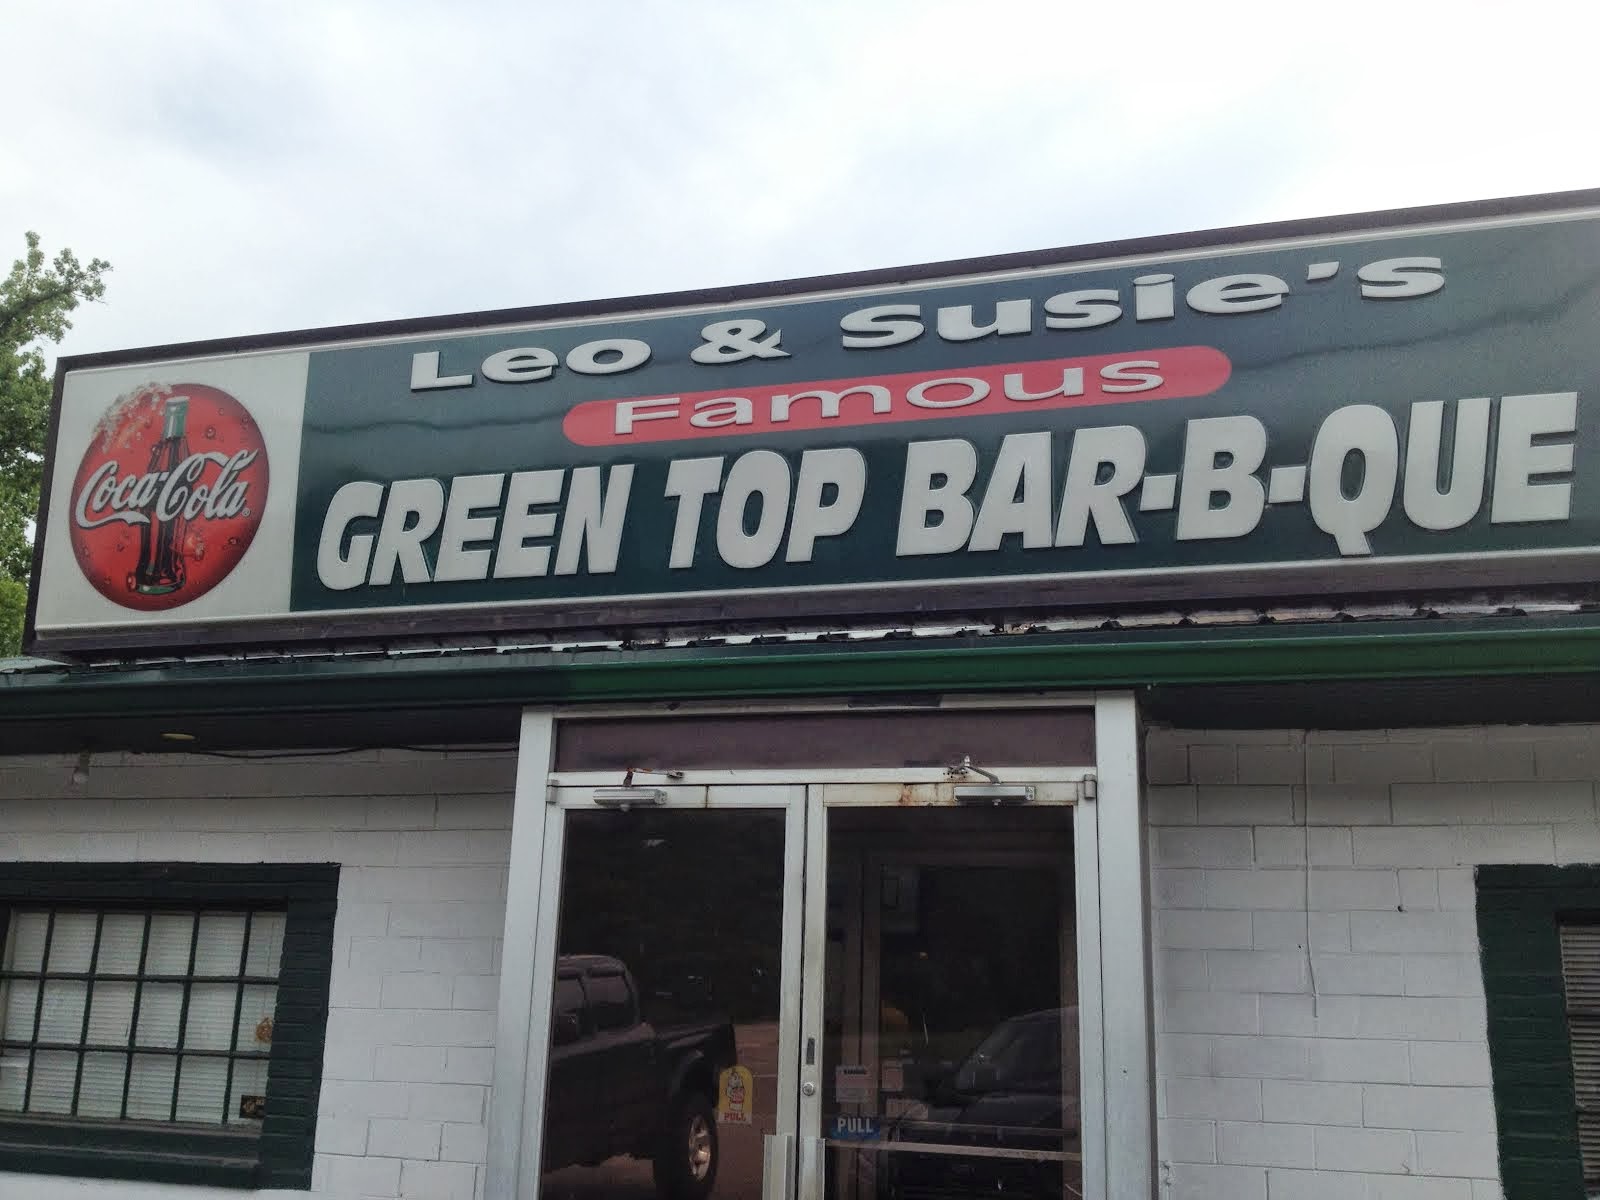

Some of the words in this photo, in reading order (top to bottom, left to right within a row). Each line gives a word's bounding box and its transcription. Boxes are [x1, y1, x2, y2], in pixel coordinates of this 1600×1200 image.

[410, 338, 652, 391] Leo
[690, 318, 791, 365] &
[614, 359, 1166, 436] Famous
[75, 449, 258, 528] Coca-Cola
[316, 463, 636, 591] GREEN
[664, 447, 868, 569] TOP
[895, 391, 1579, 557] BAR-B-QUE
[724, 1112, 747, 1122] PULL
[837, 1117, 874, 1133] PULL
